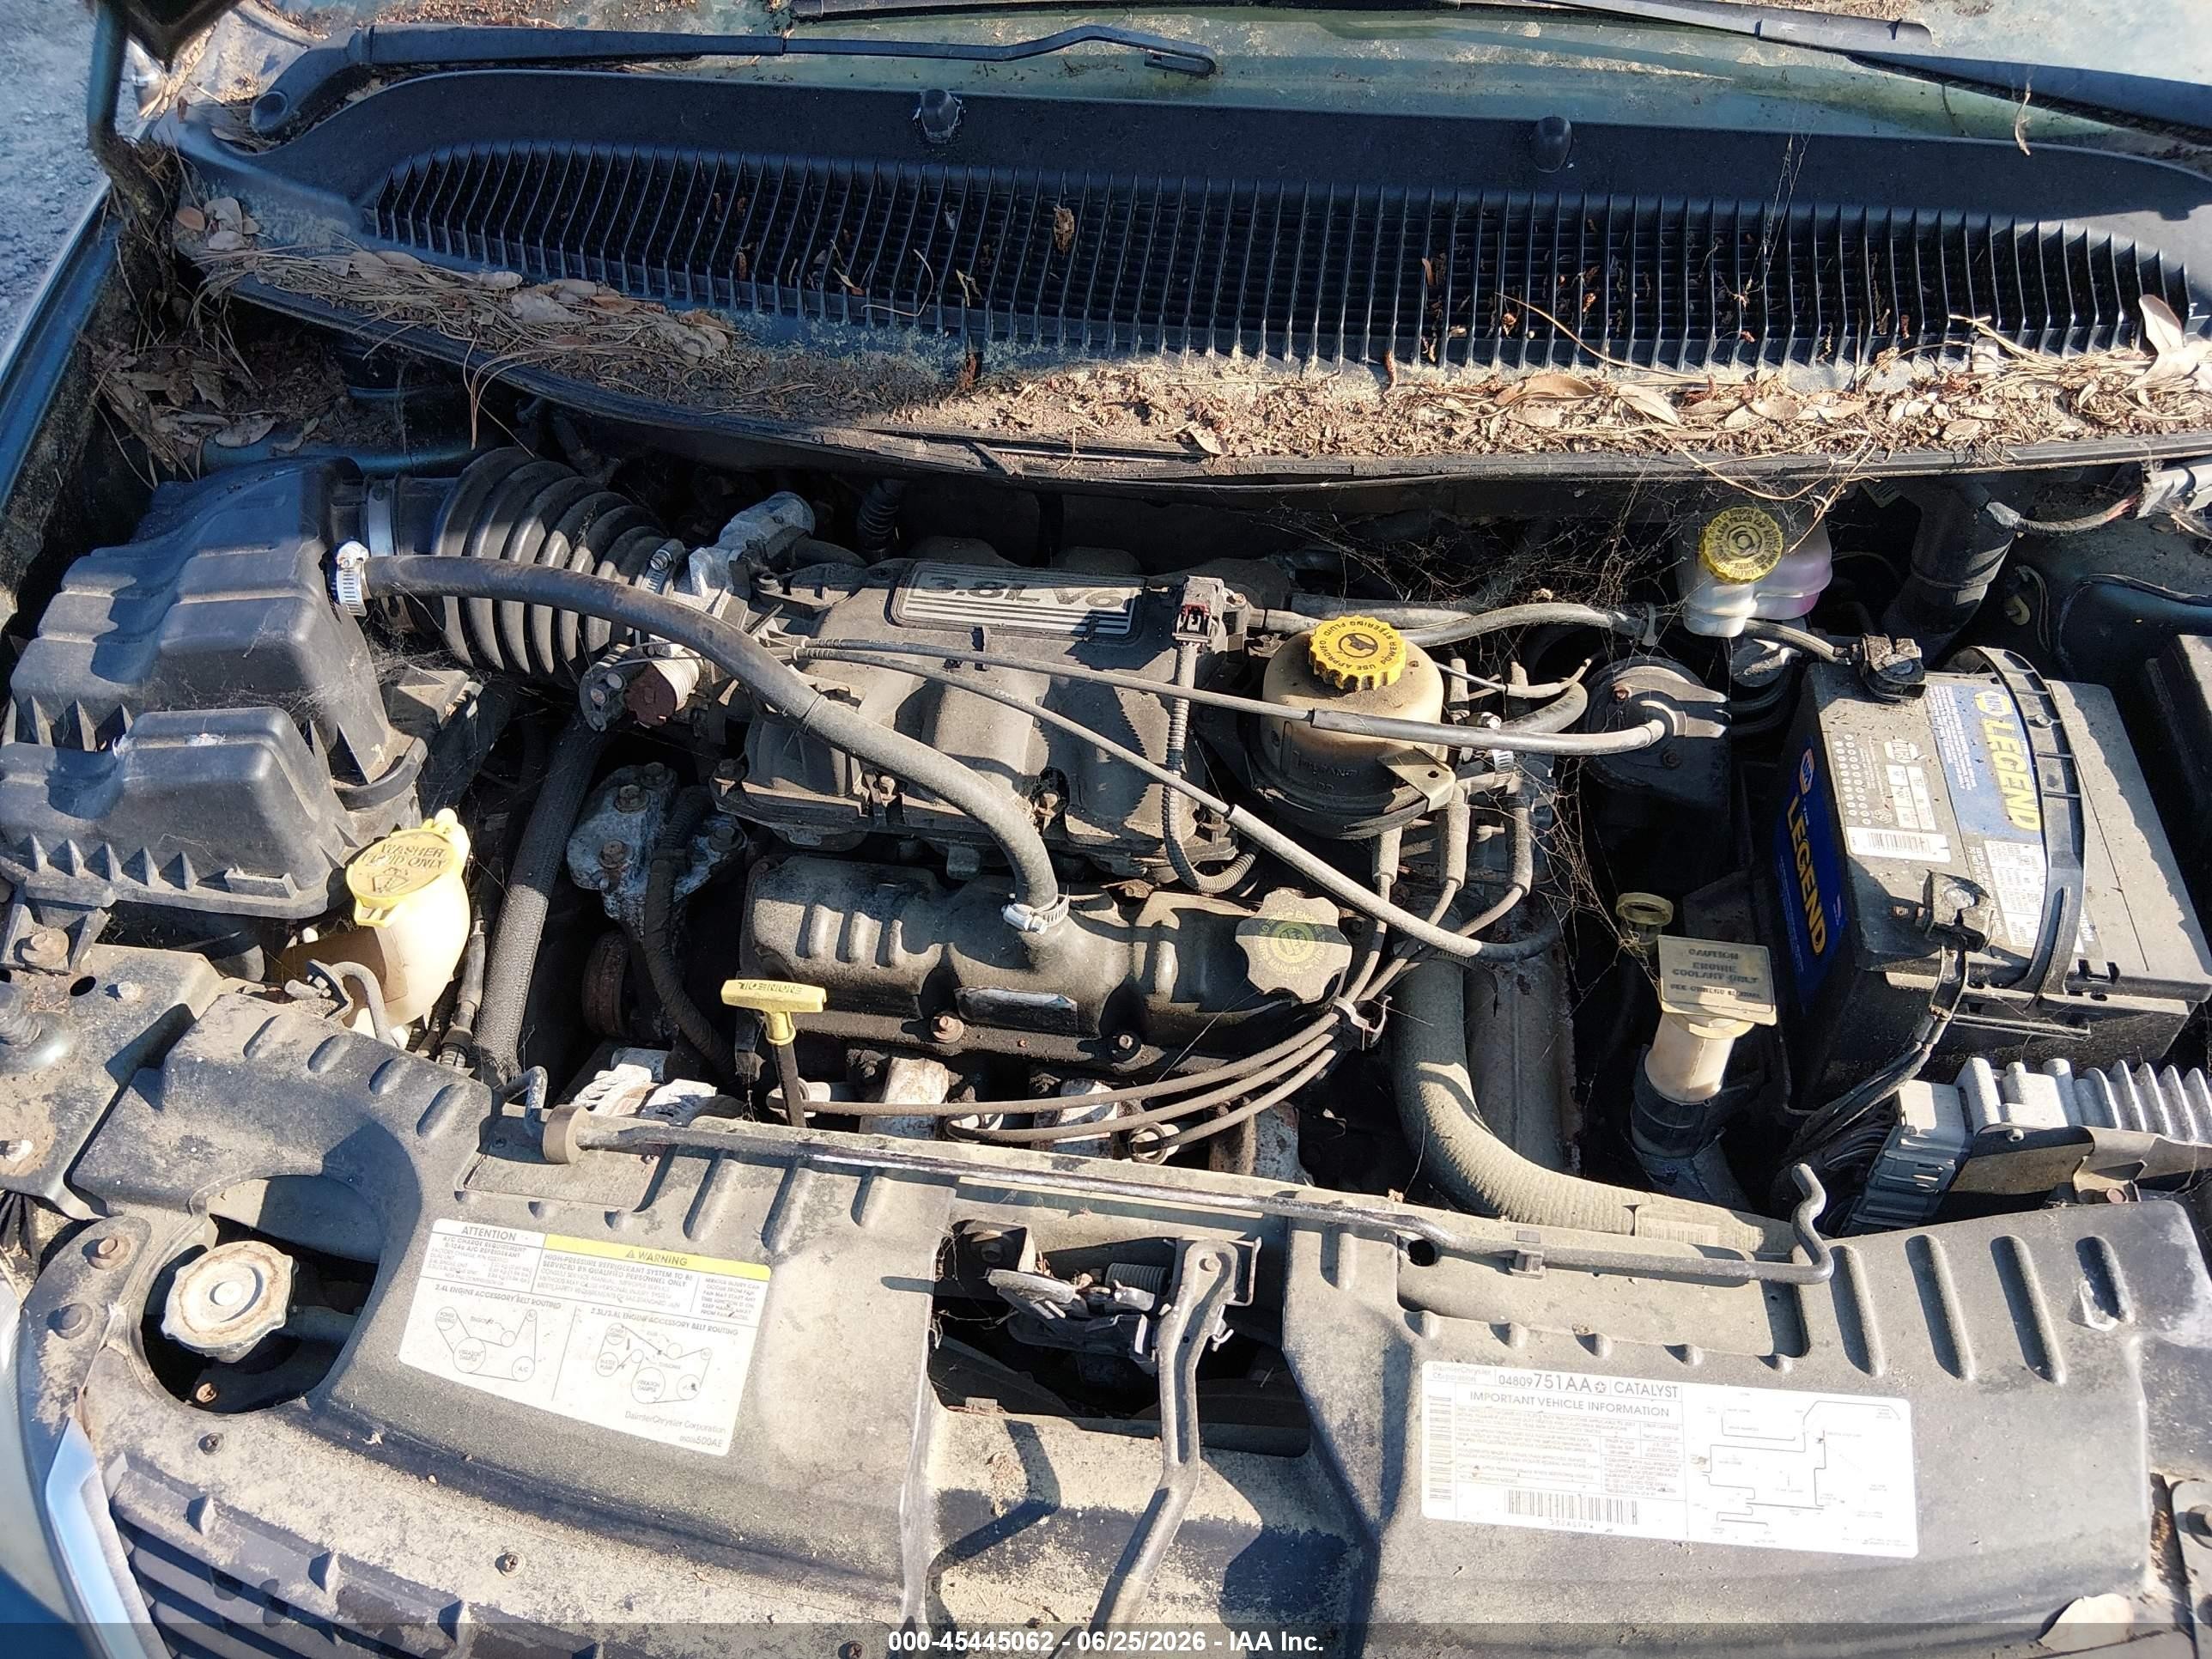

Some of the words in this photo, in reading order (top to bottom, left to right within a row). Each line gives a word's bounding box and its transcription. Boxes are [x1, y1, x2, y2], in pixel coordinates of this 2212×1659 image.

[1324, 623, 1346, 636] FLUID
[1350, 621, 1394, 640] STEERING
[1319, 640, 1352, 669] APPROVED
[1380, 641, 1398, 665] POWER
[1981, 718, 2041, 832] LEGEND
[381, 843, 447, 859] WASHER
[362, 852, 404, 867] FLUID
[408, 857, 447, 871] ONLY
[1787, 793, 1826, 956] LEGEND
[1687, 948, 1739, 961] CAUTION
[1268, 959, 1304, 975] MANUAL
[1692, 962, 1737, 974] ENGINE
[1672, 969, 1724, 981] COOLANT
[1727, 974, 1759, 984] ONLY
[738, 981, 758, 991] OIL
[758, 982, 804, 995] ENGINE
[457, 1237, 483, 1247] CHARGE
[461, 1226, 517, 1242] ATTENTION
[479, 1248, 520, 1258] REFRIGERANT
[638, 1250, 688, 1267] WARNING
[543, 1260, 575, 1271] SERVICED
[588, 1267, 623, 1279] QUALIFIED
[625, 1273, 665, 1285] PERSONNEL
[544, 1254, 597, 1267] HIGH-PRESSURE
[646, 1268, 672, 1278] SYSTEM
[449, 1285, 475, 1296] ENGINE
[475, 1291, 515, 1303] ACCESSORY
[515, 1295, 531, 1304] BELT
[531, 1298, 562, 1310] ROUTING
[623, 1312, 648, 1323] ENGINE
[647, 1316, 690, 1328] ACCESSORY
[691, 1322, 706, 1331] BELT
[707, 1325, 738, 1336] ROUTING
[1432, 1364, 1492, 1376] DaimlerChrysler
[1432, 1372, 1477, 1382] Corporation
[1498, 1373, 1592, 1393] 04809751AA
[1613, 1381, 1679, 1399] CATALYST
[1469, 1391, 1536, 1407] IMPORTANT
[1537, 1397, 1584, 1411] VEHICLE
[1588, 1401, 1670, 1418] INFORMATION
[625, 1411, 683, 1427] DaimlerChrysler
[684, 1420, 726, 1434] Corporation
